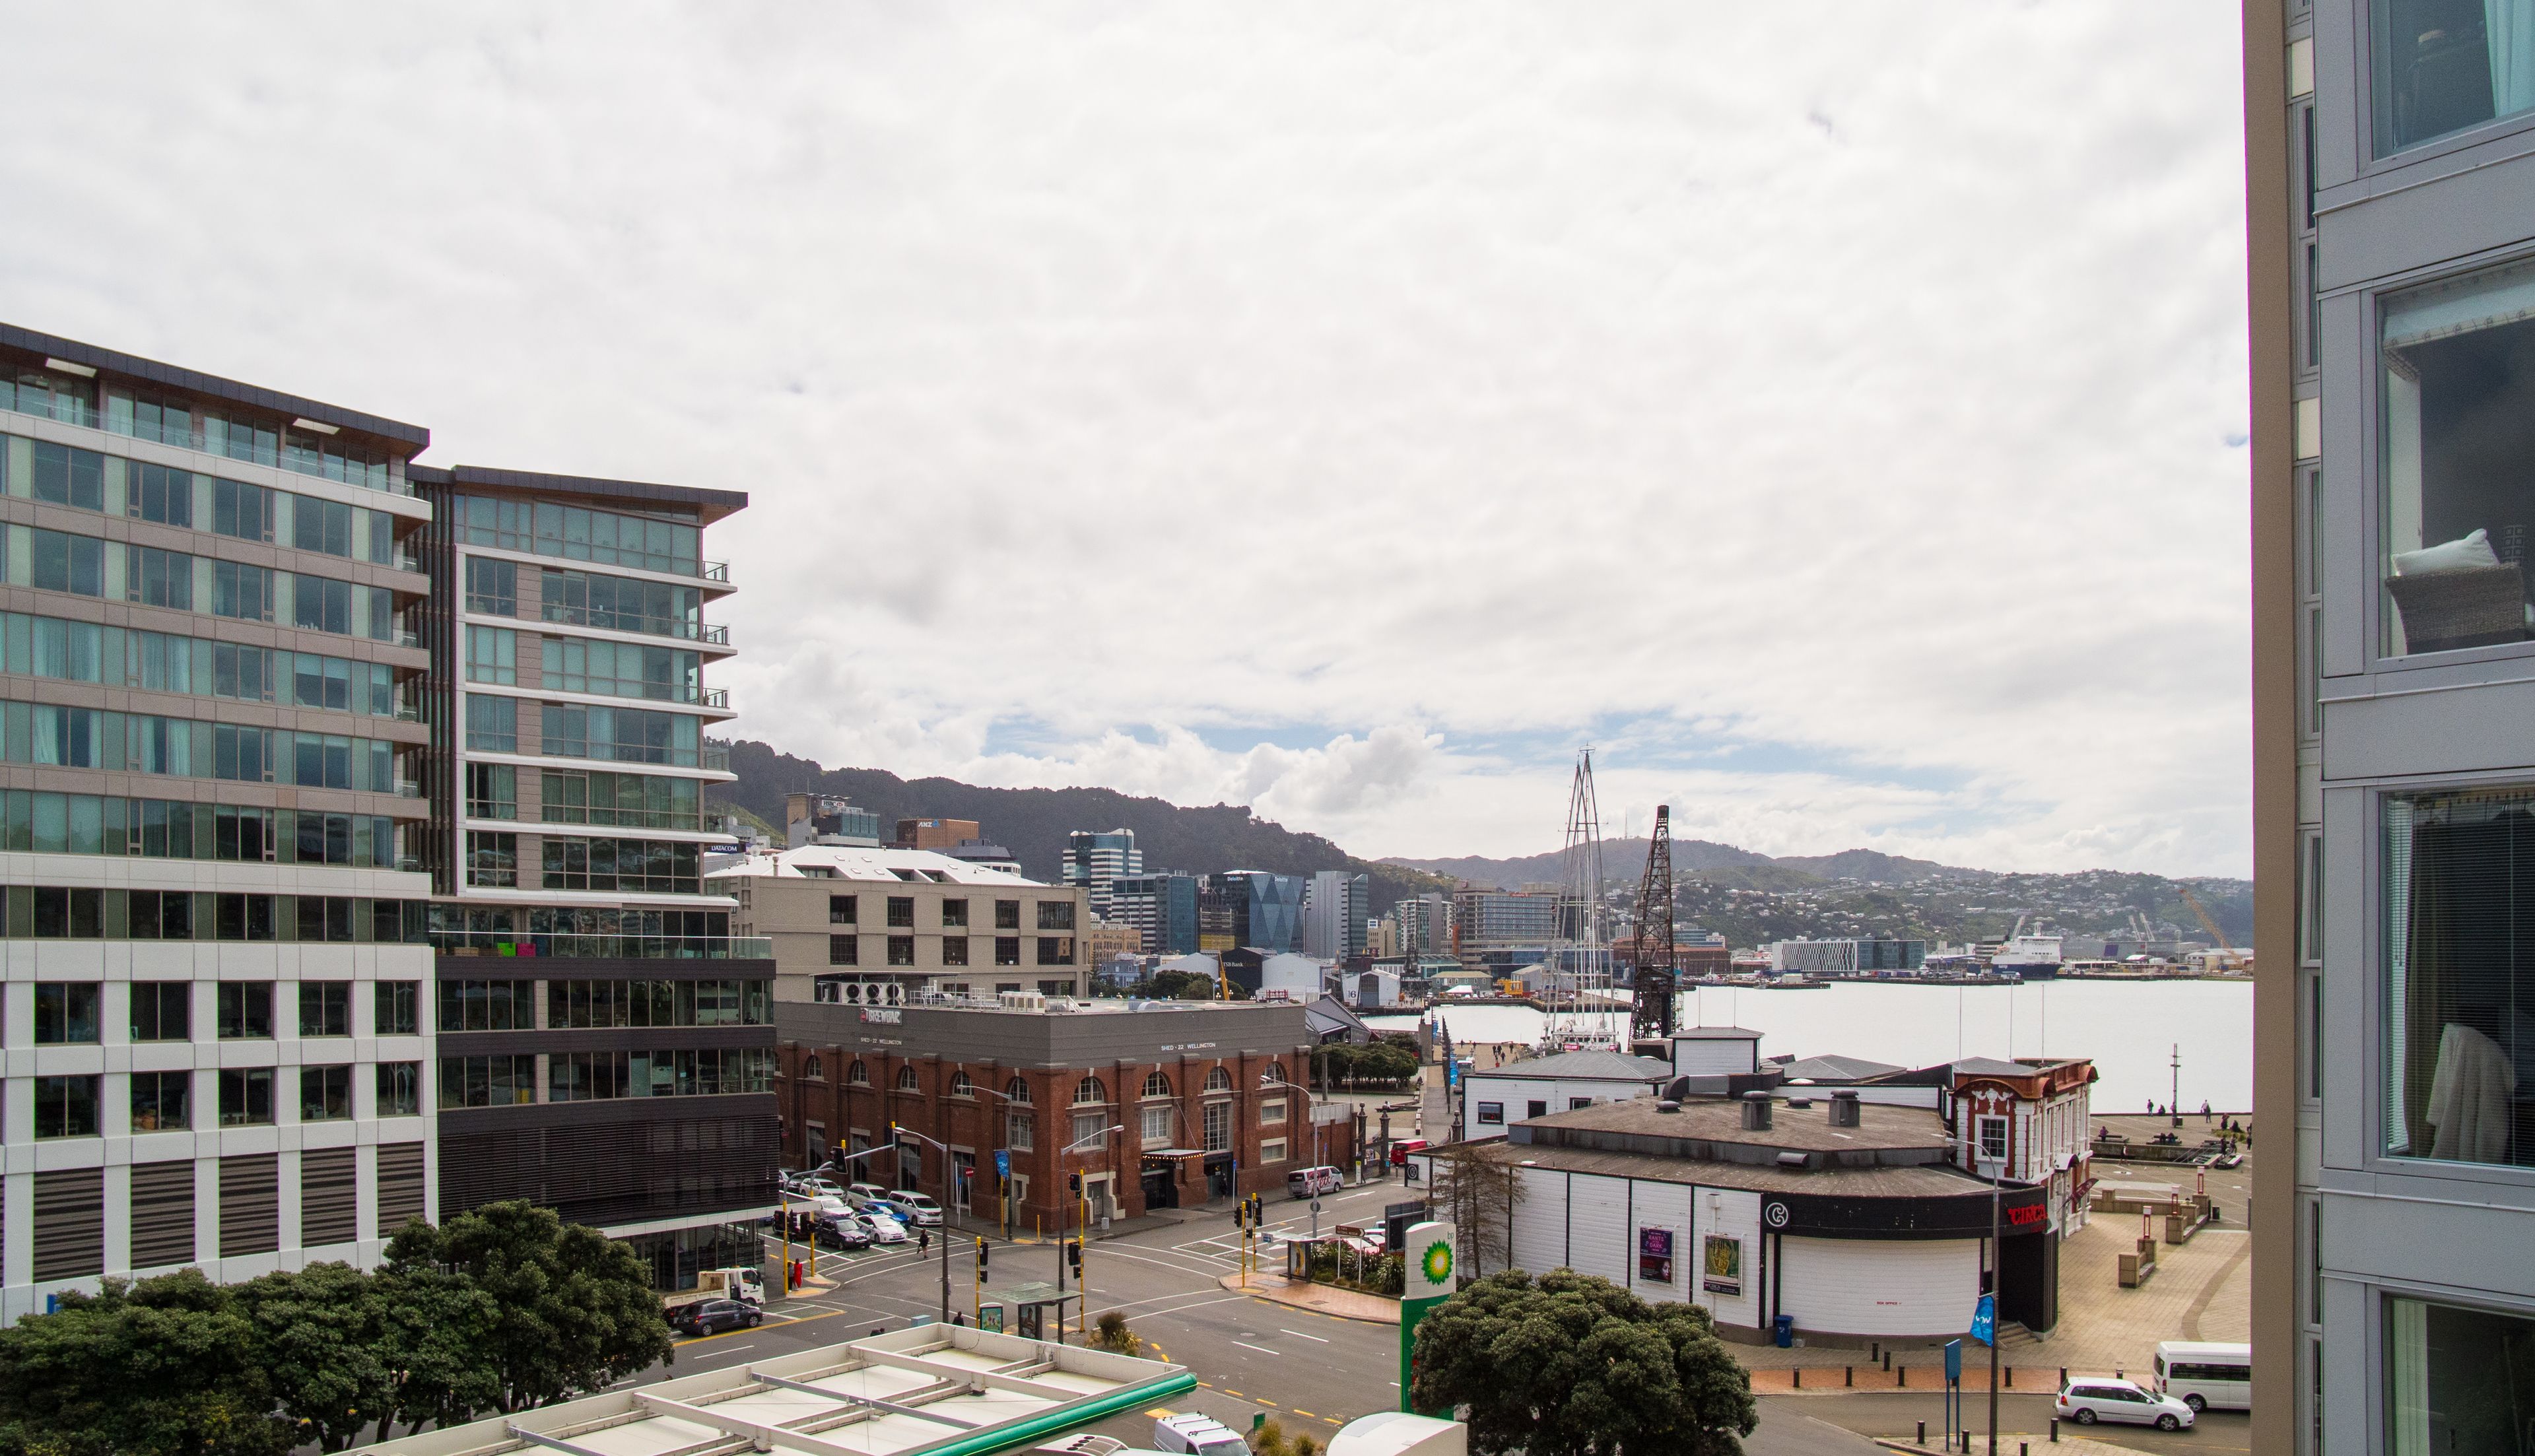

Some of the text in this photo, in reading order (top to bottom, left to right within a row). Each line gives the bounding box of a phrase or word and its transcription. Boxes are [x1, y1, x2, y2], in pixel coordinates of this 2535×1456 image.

[868, 1010, 900, 1023] BREWBAR
[2008, 1203, 2048, 1226] CIRCA
[1447, 1231, 1454, 1241] bp
